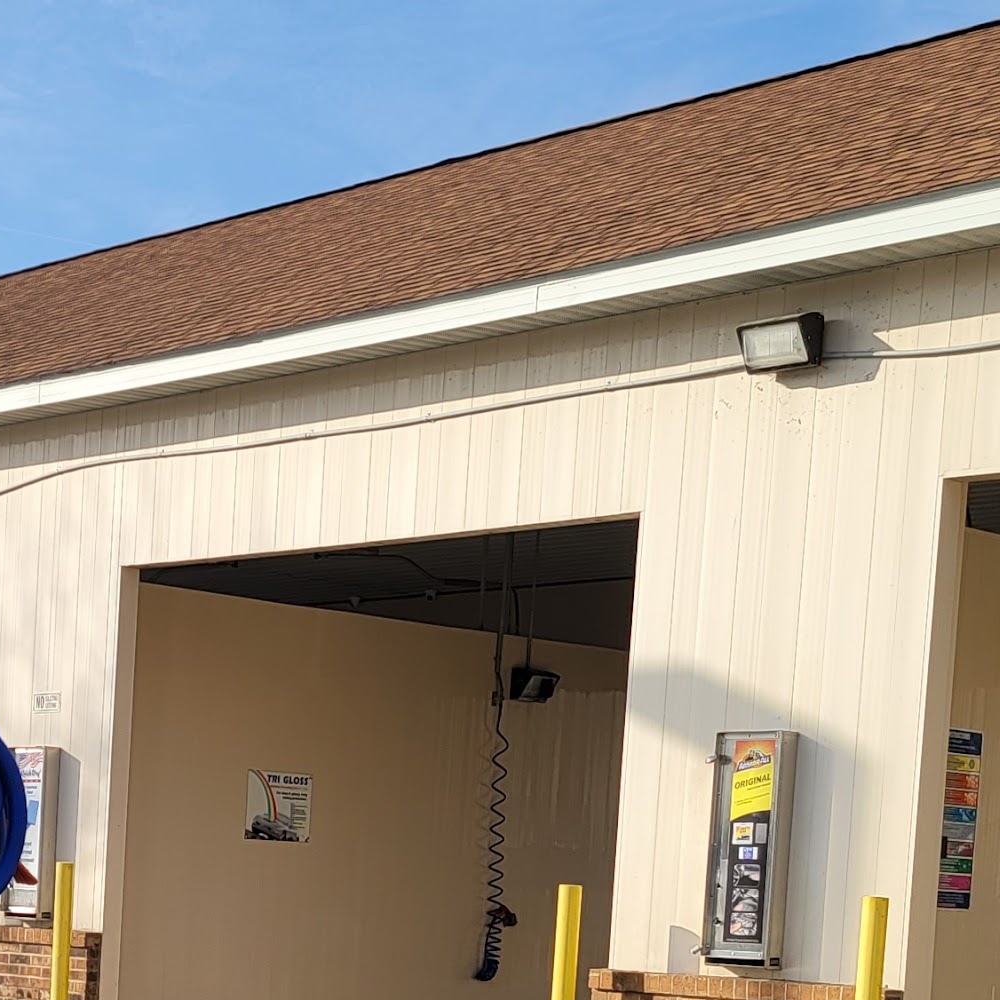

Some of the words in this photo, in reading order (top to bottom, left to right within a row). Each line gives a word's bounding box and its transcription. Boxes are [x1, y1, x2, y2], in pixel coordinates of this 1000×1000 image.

[267, 774, 280, 784] TRI
[283, 776, 309, 786] GLOSS
[734, 773, 771, 789] ORIGINAL
